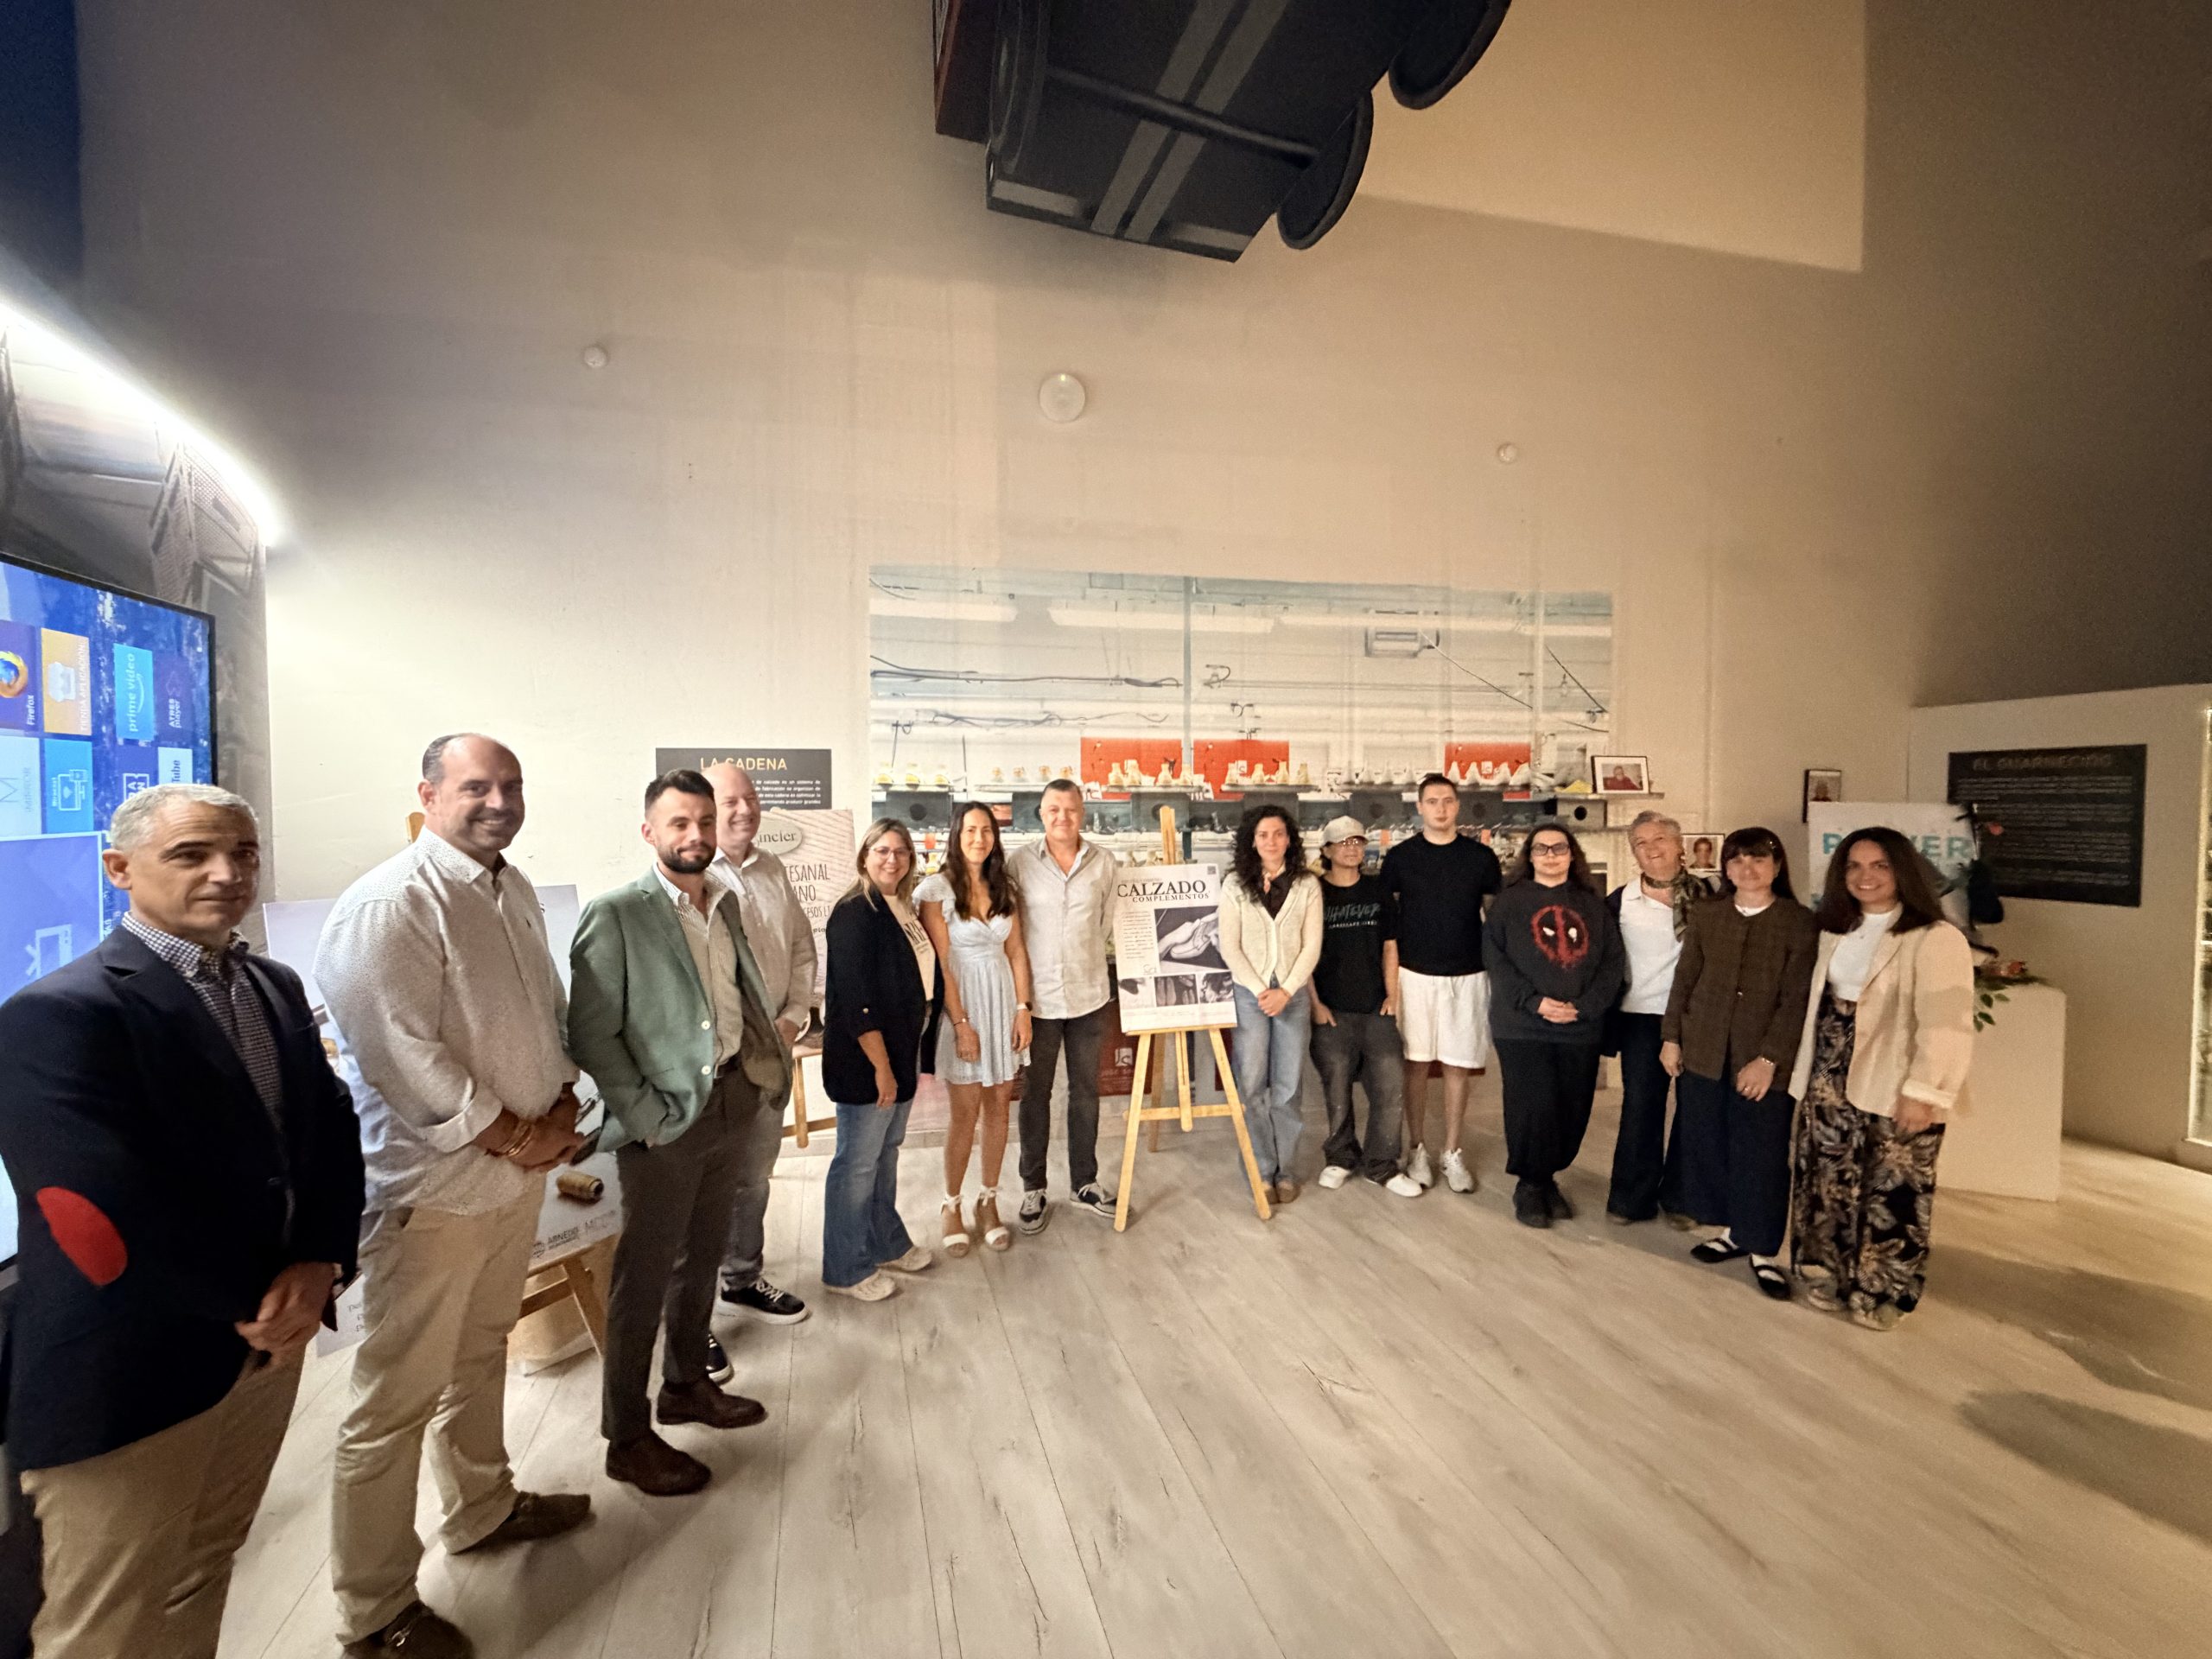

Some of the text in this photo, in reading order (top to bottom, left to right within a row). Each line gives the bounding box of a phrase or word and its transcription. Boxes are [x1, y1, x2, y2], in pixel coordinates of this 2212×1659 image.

[124, 652, 138, 733] prime video
[26, 694, 35, 726] Firefox
[1822, 832, 1971, 859] PER
[1117, 880, 1206, 898] CALZADO
[1132, 893, 1210, 903] COMPLEMENTOS
